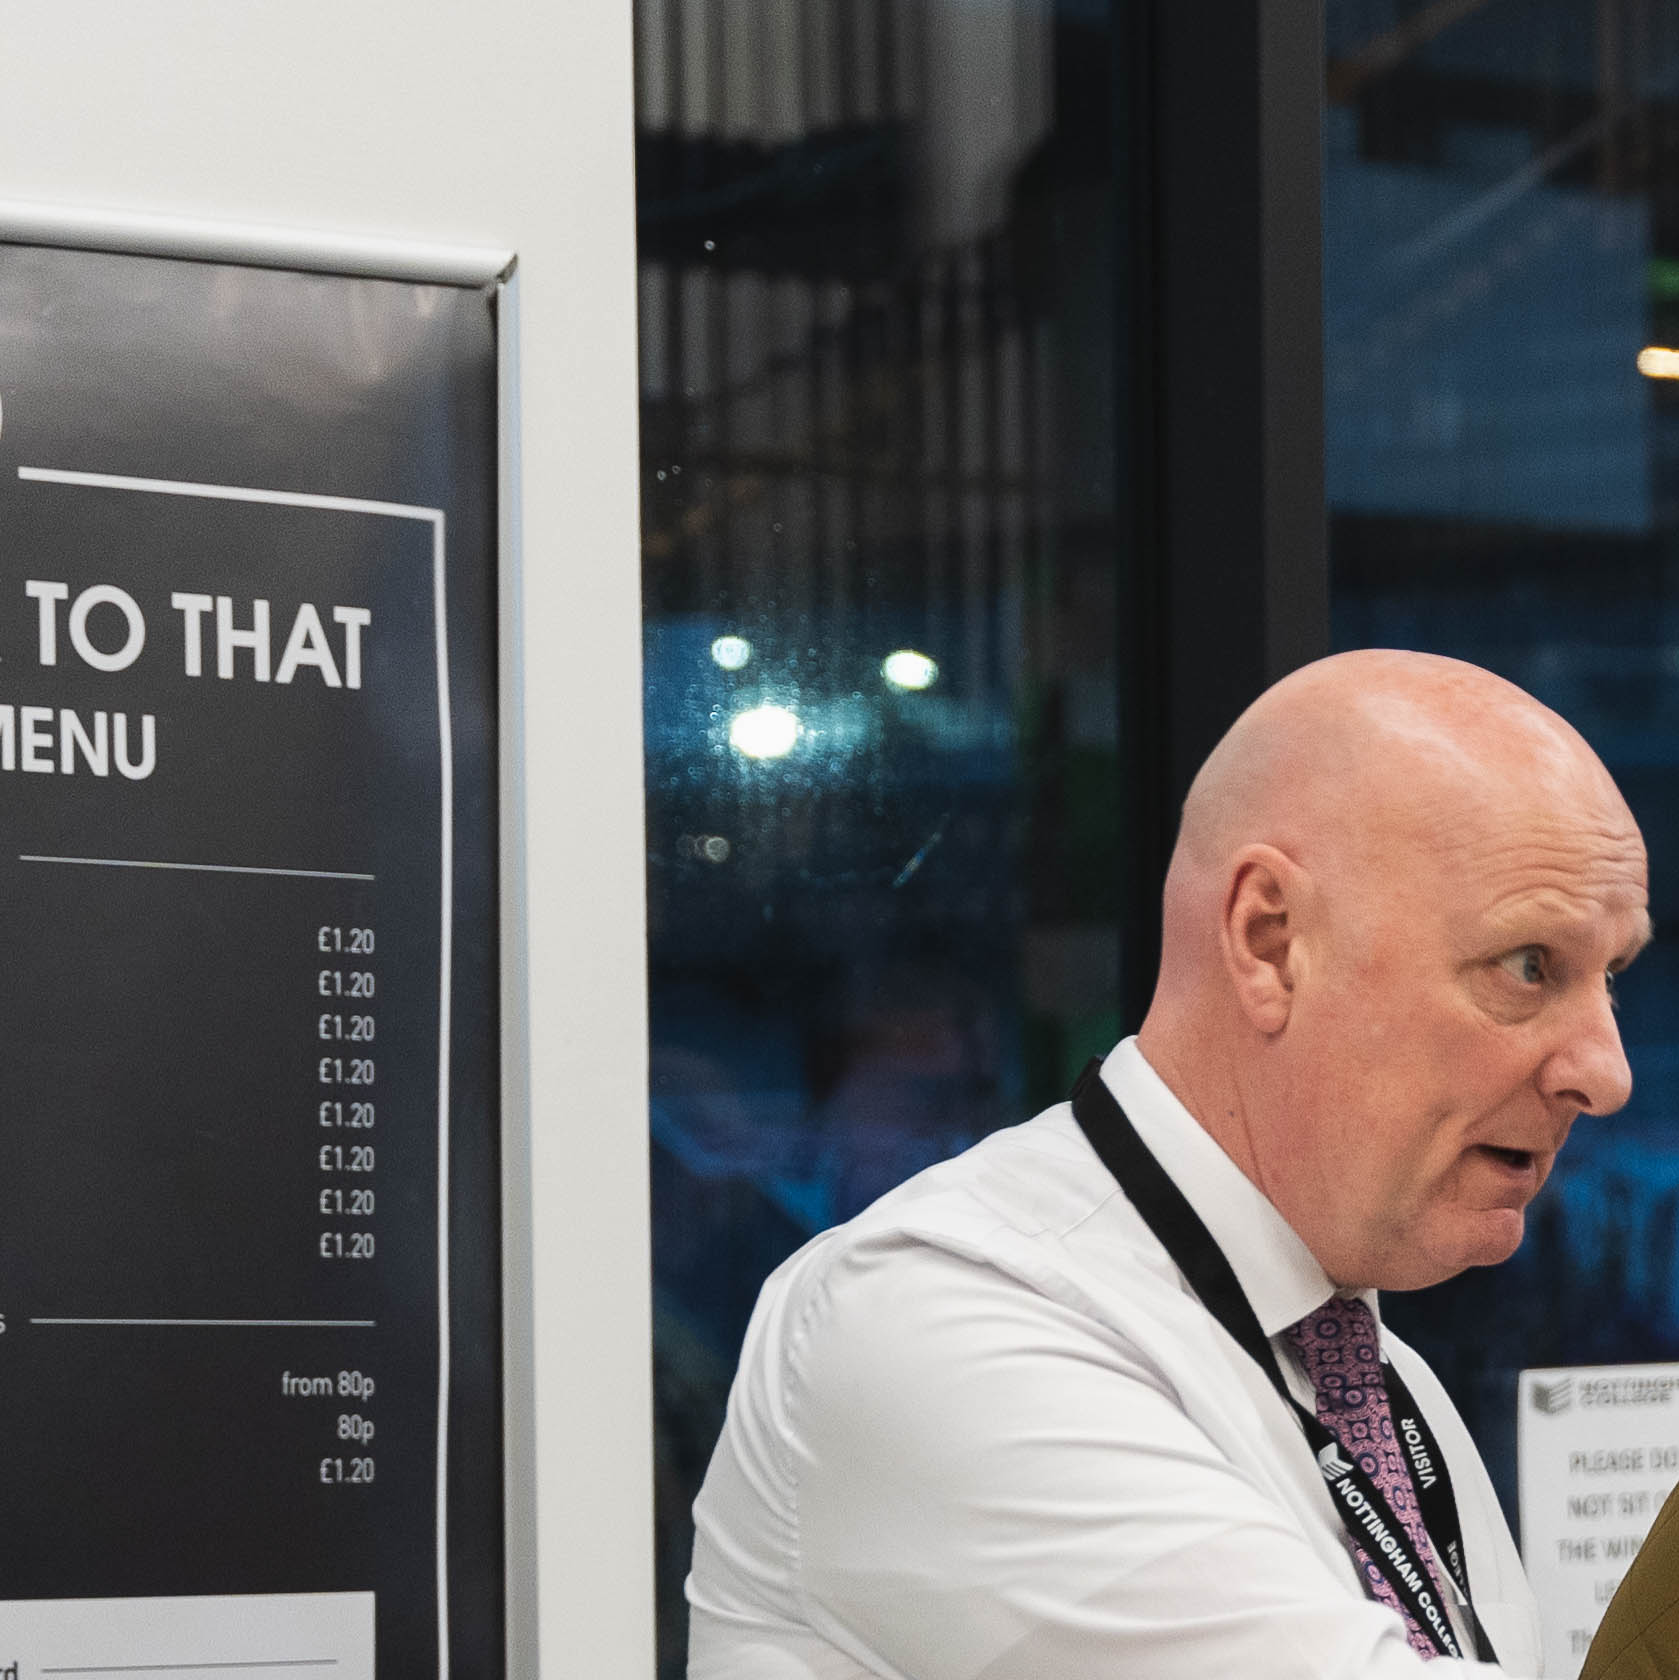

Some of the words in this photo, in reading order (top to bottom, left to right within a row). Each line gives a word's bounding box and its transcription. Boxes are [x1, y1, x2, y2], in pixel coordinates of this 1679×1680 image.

[25, 580, 146, 672] TO
[171, 591, 371, 689] THAT
[0, 705, 156, 780] ENU
[318, 926, 375, 954] £1.20
[318, 970, 375, 998] £1.20
[318, 1013, 375, 1041] £1.20
[318, 1057, 375, 1085] £1.20
[318, 1101, 375, 1128] £1.20
[318, 1145, 375, 1172] £1.20
[318, 1188, 375, 1215] £1.20
[318, 1232, 375, 1259] £1.20
[282, 1371, 333, 1396] from
[338, 1371, 375, 1402] 80p
[338, 1414, 375, 1446] 80p
[1400, 1418, 1437, 1489] VISITOR
[1569, 1448, 1643, 1473] PLEASE
[1651, 1446, 1678, 1470] DO
[320, 1457, 375, 1484] £1.20
[1567, 1492, 1610, 1518] NOT
[1557, 1537, 1596, 1561] THE
[1337, 1477, 1424, 1594] NOTTINGHAM
[1418, 1592, 1463, 1659] COLLEG
